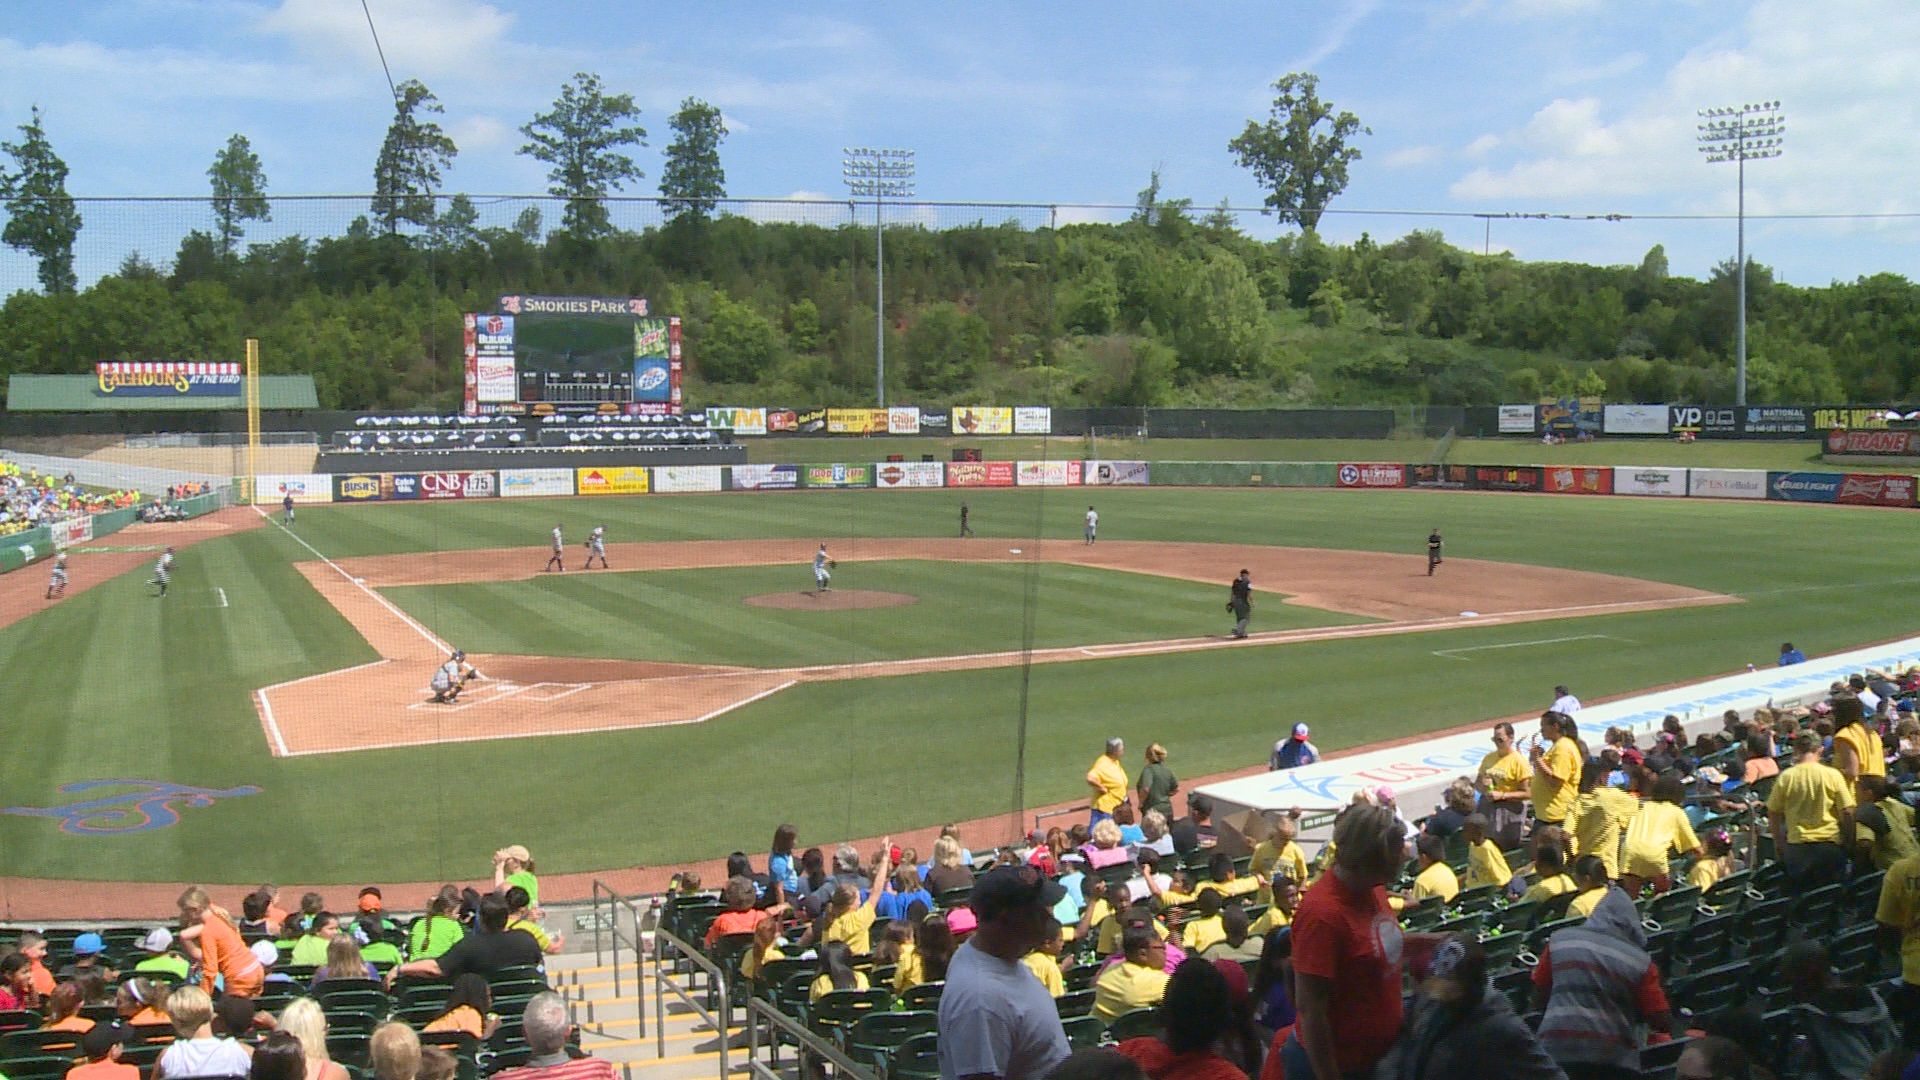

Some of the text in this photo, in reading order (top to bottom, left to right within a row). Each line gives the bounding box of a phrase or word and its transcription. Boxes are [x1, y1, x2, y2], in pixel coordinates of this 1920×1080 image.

[524, 298, 627, 314] SMOKIES PARK
[189, 374, 199, 385] AT
[202, 375, 218, 384] THE
[219, 375, 240, 384] YARD
[1674, 408, 1701, 427] yp
[1762, 408, 1805, 417] NATIONAL
[1849, 432, 1907, 452] TRANE
[343, 481, 378, 492] BUSH'S
[421, 473, 461, 491] CNB
[1804, 481, 1838, 491] LIGHT
